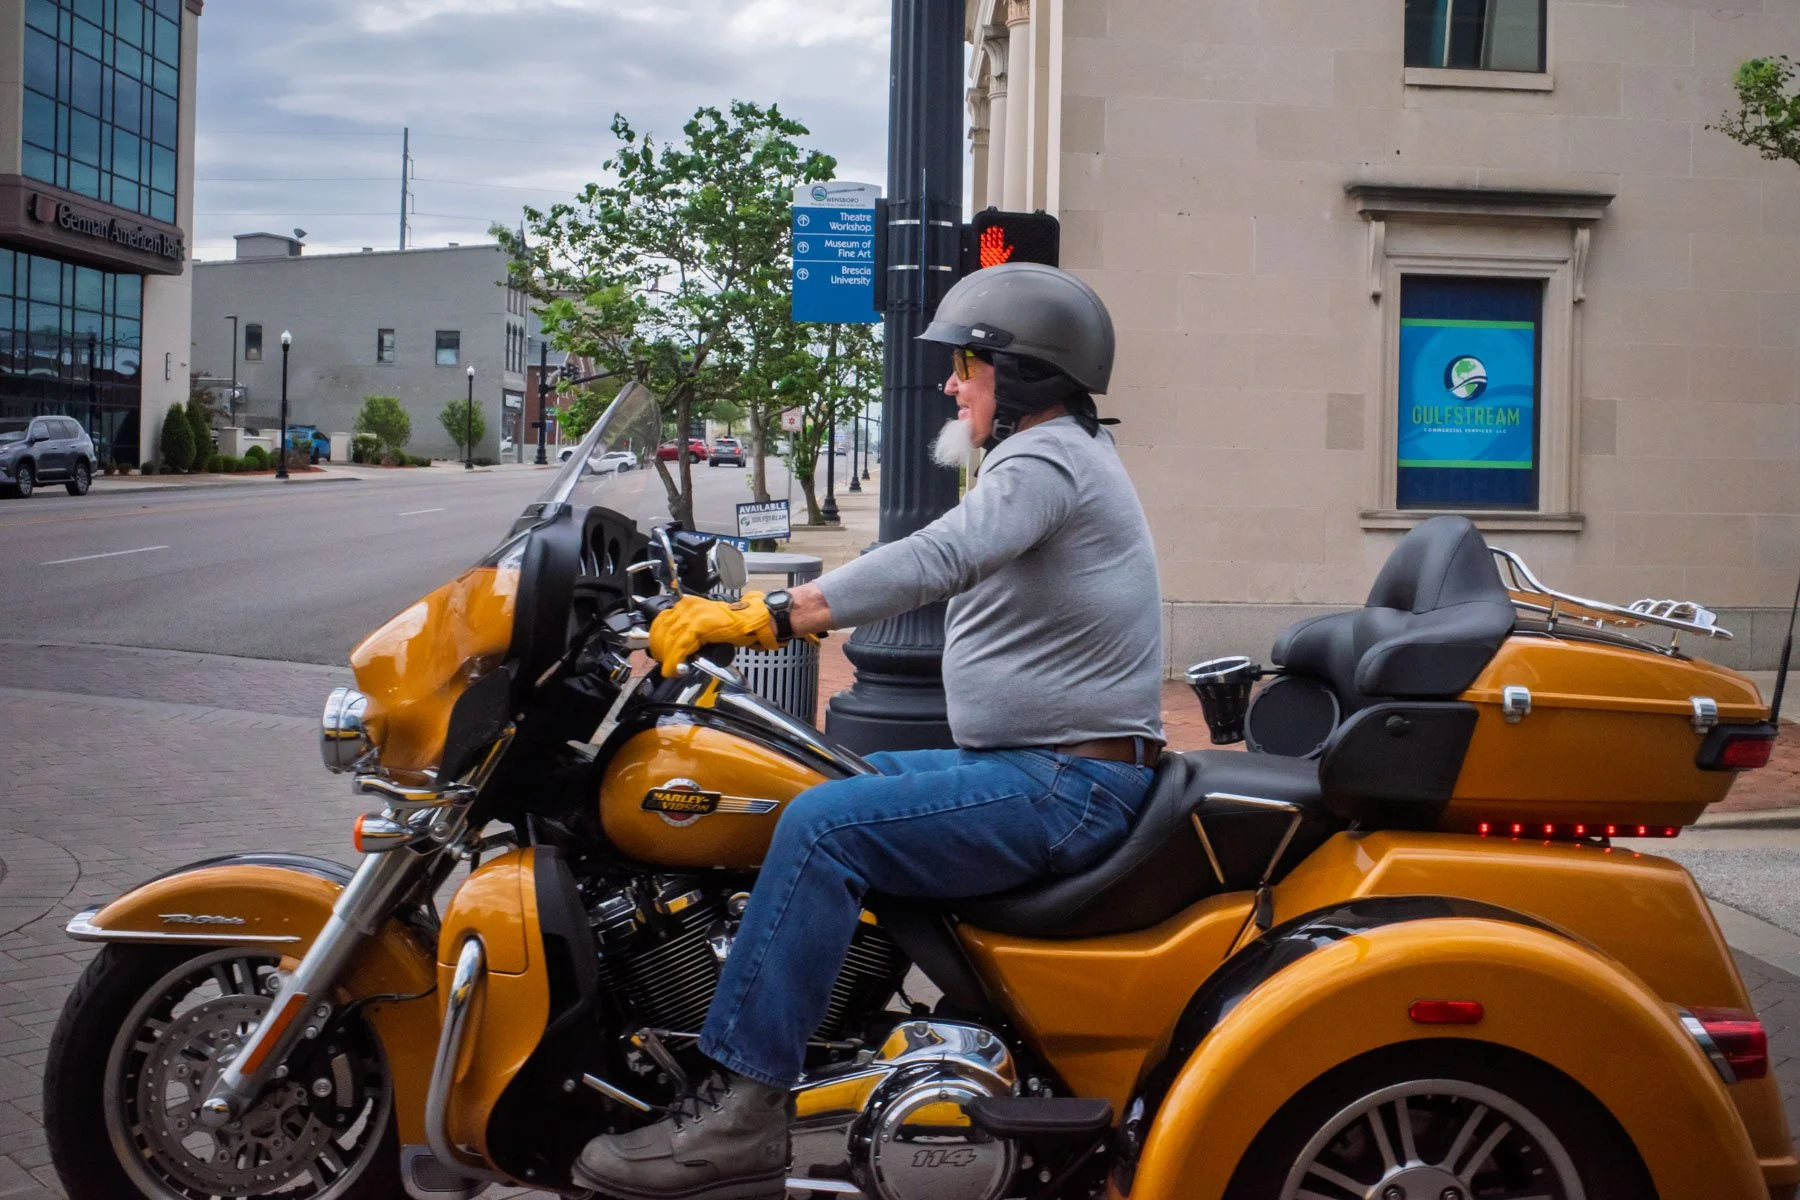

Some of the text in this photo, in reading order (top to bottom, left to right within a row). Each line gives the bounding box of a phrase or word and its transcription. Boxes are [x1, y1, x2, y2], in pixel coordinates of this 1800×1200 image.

[840, 212, 872, 222] Theatre
[58, 203, 109, 238] German
[110, 219, 161, 254] American
[829, 222, 872, 233] Workshop
[824, 239, 871, 249] Museum of
[838, 249, 871, 258] Fine Art
[841, 265, 872, 275] Brescia
[830, 275, 871, 286] University
[1412, 405, 1520, 426] GULFSTREAM
[739, 501, 787, 514] AVAILABLE
[911, 1148, 977, 1168] 114
